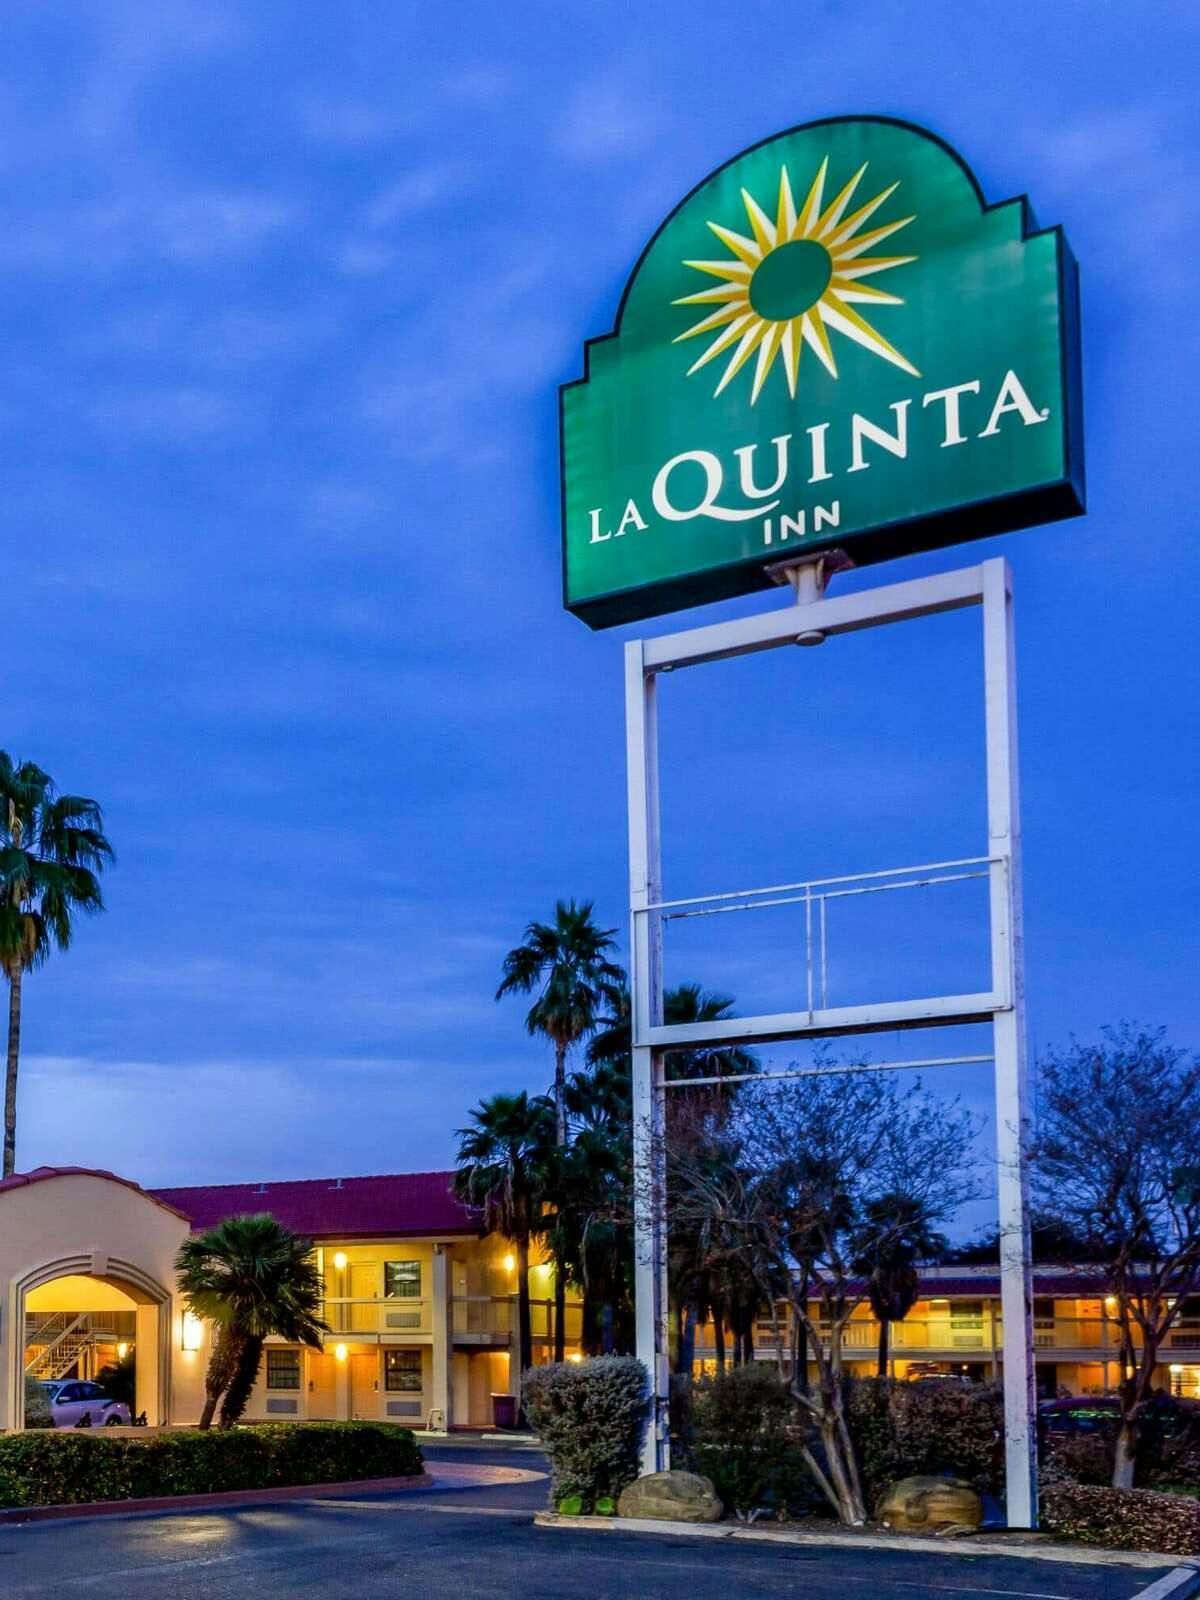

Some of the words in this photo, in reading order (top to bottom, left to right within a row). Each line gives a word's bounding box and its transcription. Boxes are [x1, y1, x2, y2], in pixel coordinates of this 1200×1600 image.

[587, 498, 649, 545] LA
[651, 369, 1050, 522] QUINTA
[763, 500, 841, 545] INN
